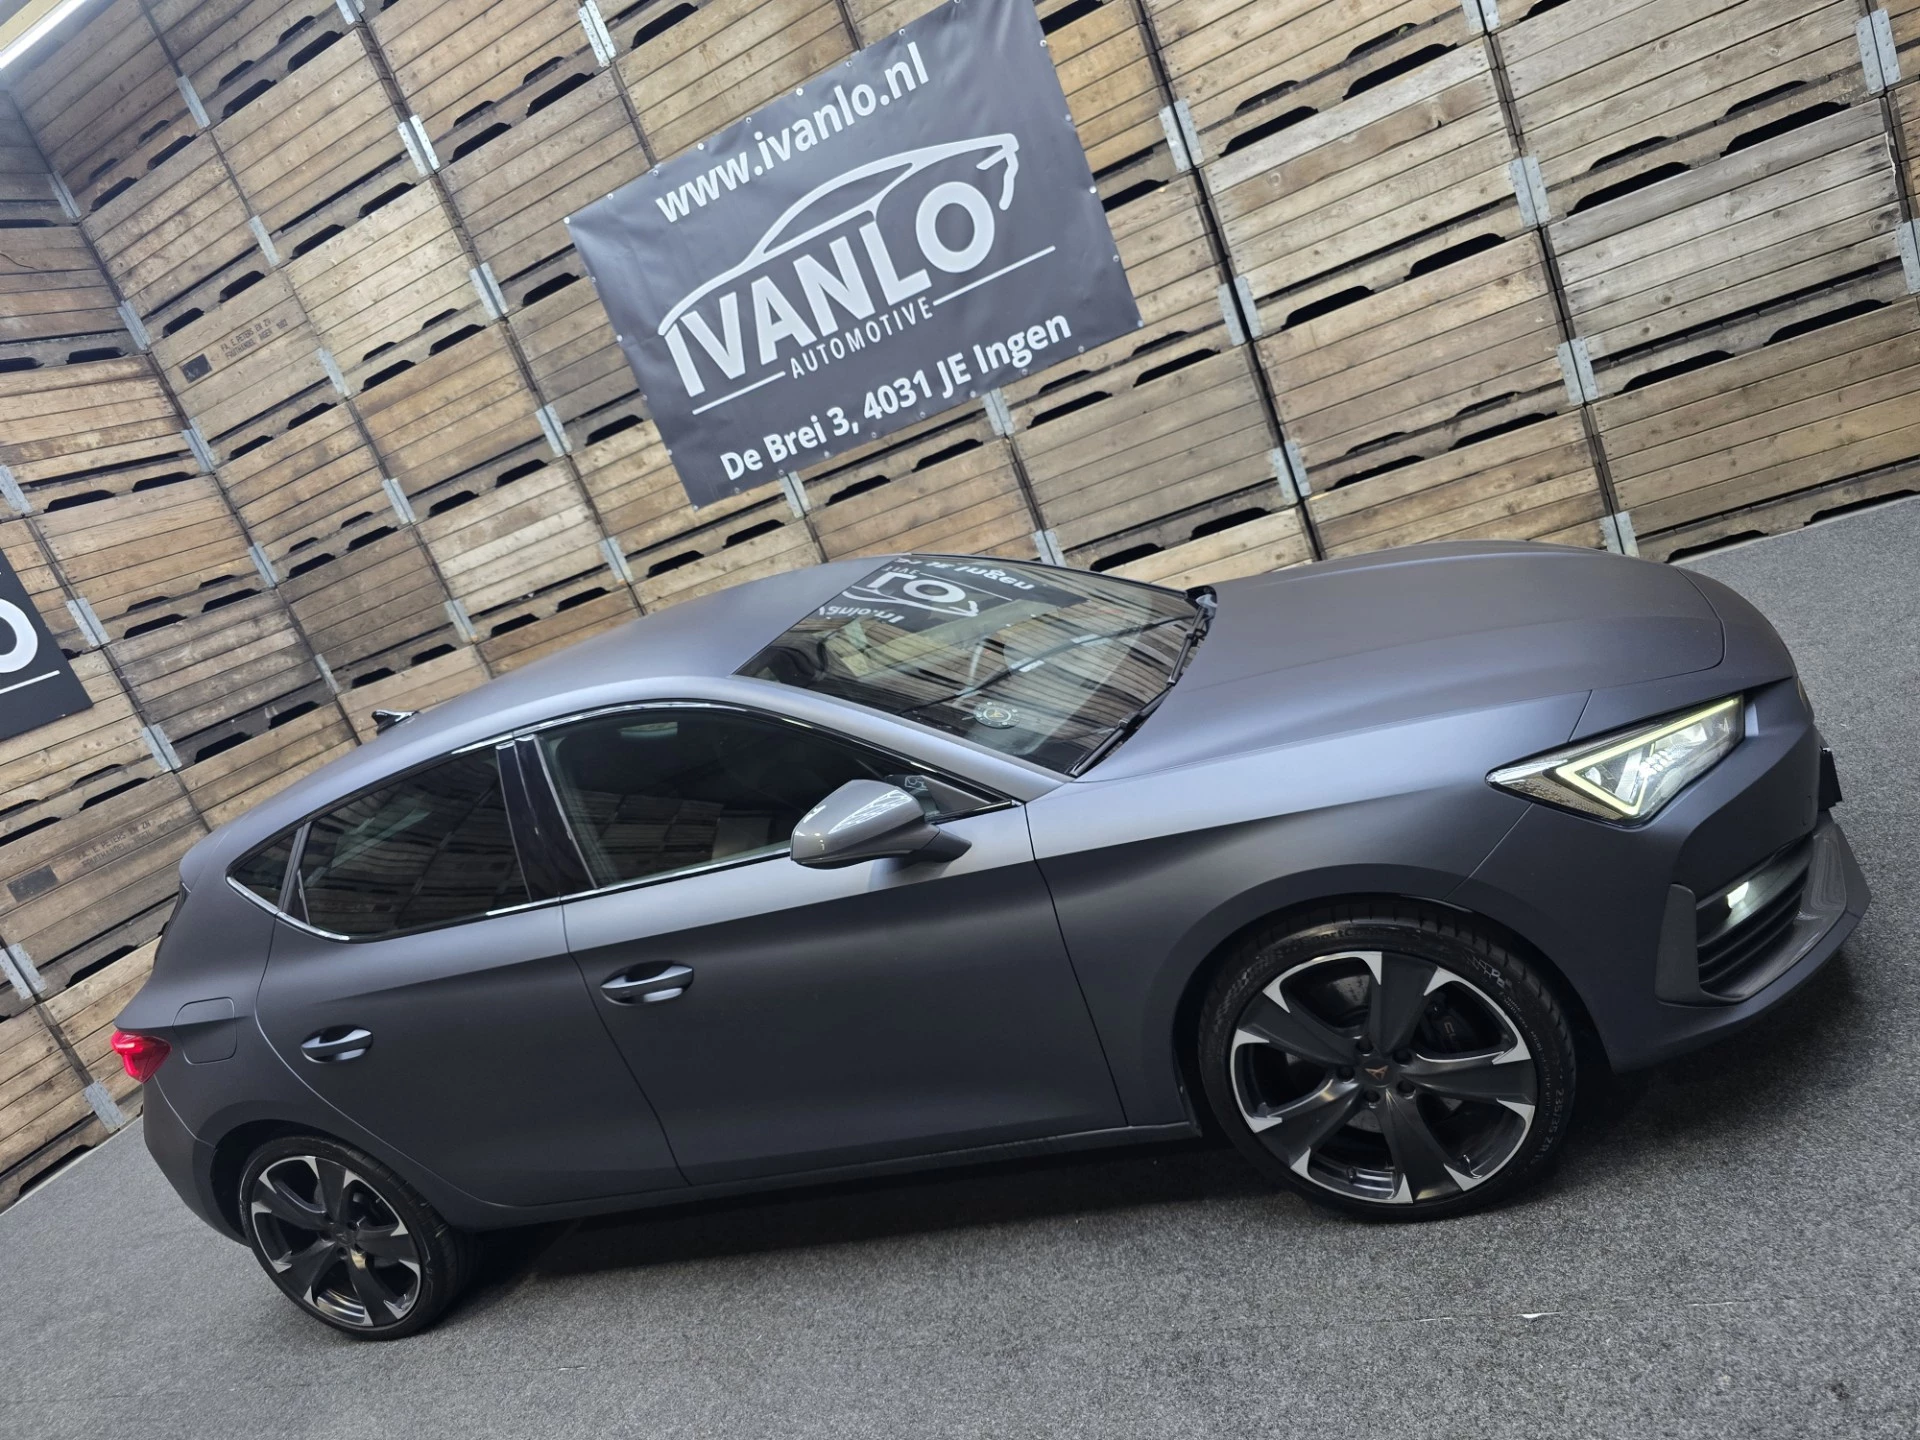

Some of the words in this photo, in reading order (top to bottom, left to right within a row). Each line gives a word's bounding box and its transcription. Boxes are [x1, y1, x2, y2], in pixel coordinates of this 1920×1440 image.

[655, 42, 930, 223] www.ivanlo.nl
[662, 181, 995, 398] IVANLO
[789, 296, 933, 379] AUTOMOTIVE
[719, 449, 764, 481] De
[763, 413, 827, 463] Brei
[826, 406, 860, 437] 3,
[863, 369, 933, 420] 4031
[937, 352, 972, 398] JE
[972, 315, 1072, 374] Ingen
